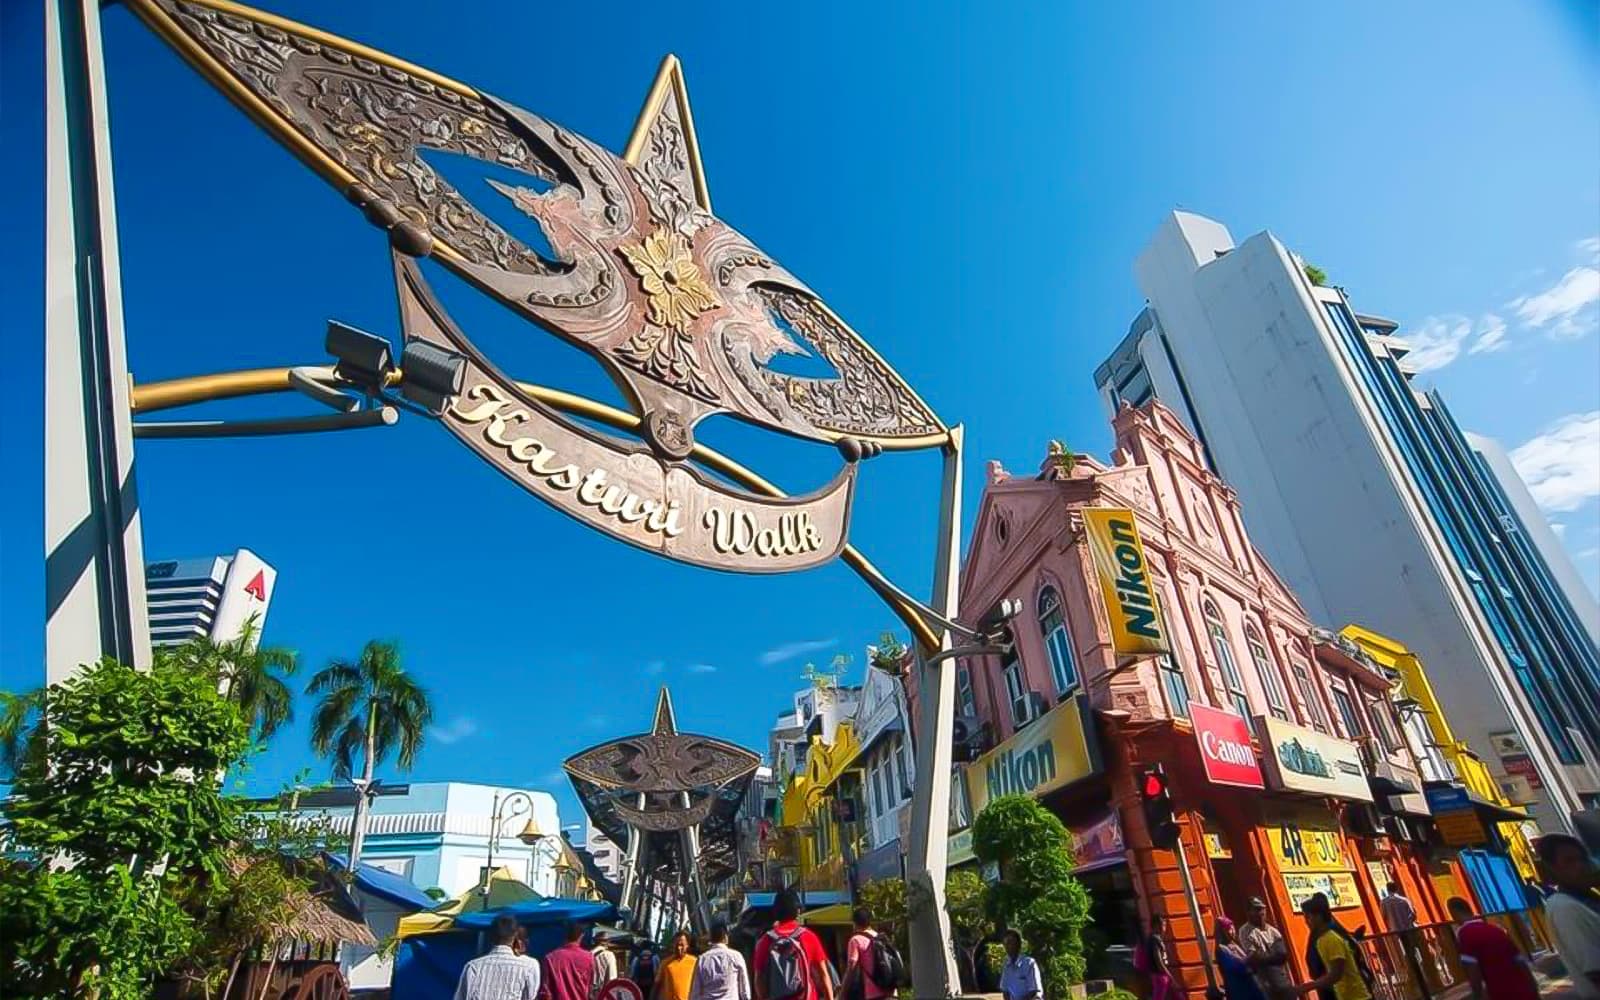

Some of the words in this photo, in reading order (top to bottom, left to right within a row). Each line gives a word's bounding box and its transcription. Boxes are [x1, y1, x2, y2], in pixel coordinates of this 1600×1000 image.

[448, 385, 684, 538] Kasturi
[703, 508, 823, 557] Walk
[1108, 519, 1160, 639] Nikon
[986, 739, 1056, 800] Nikon
[1203, 731, 1256, 768] Canon
